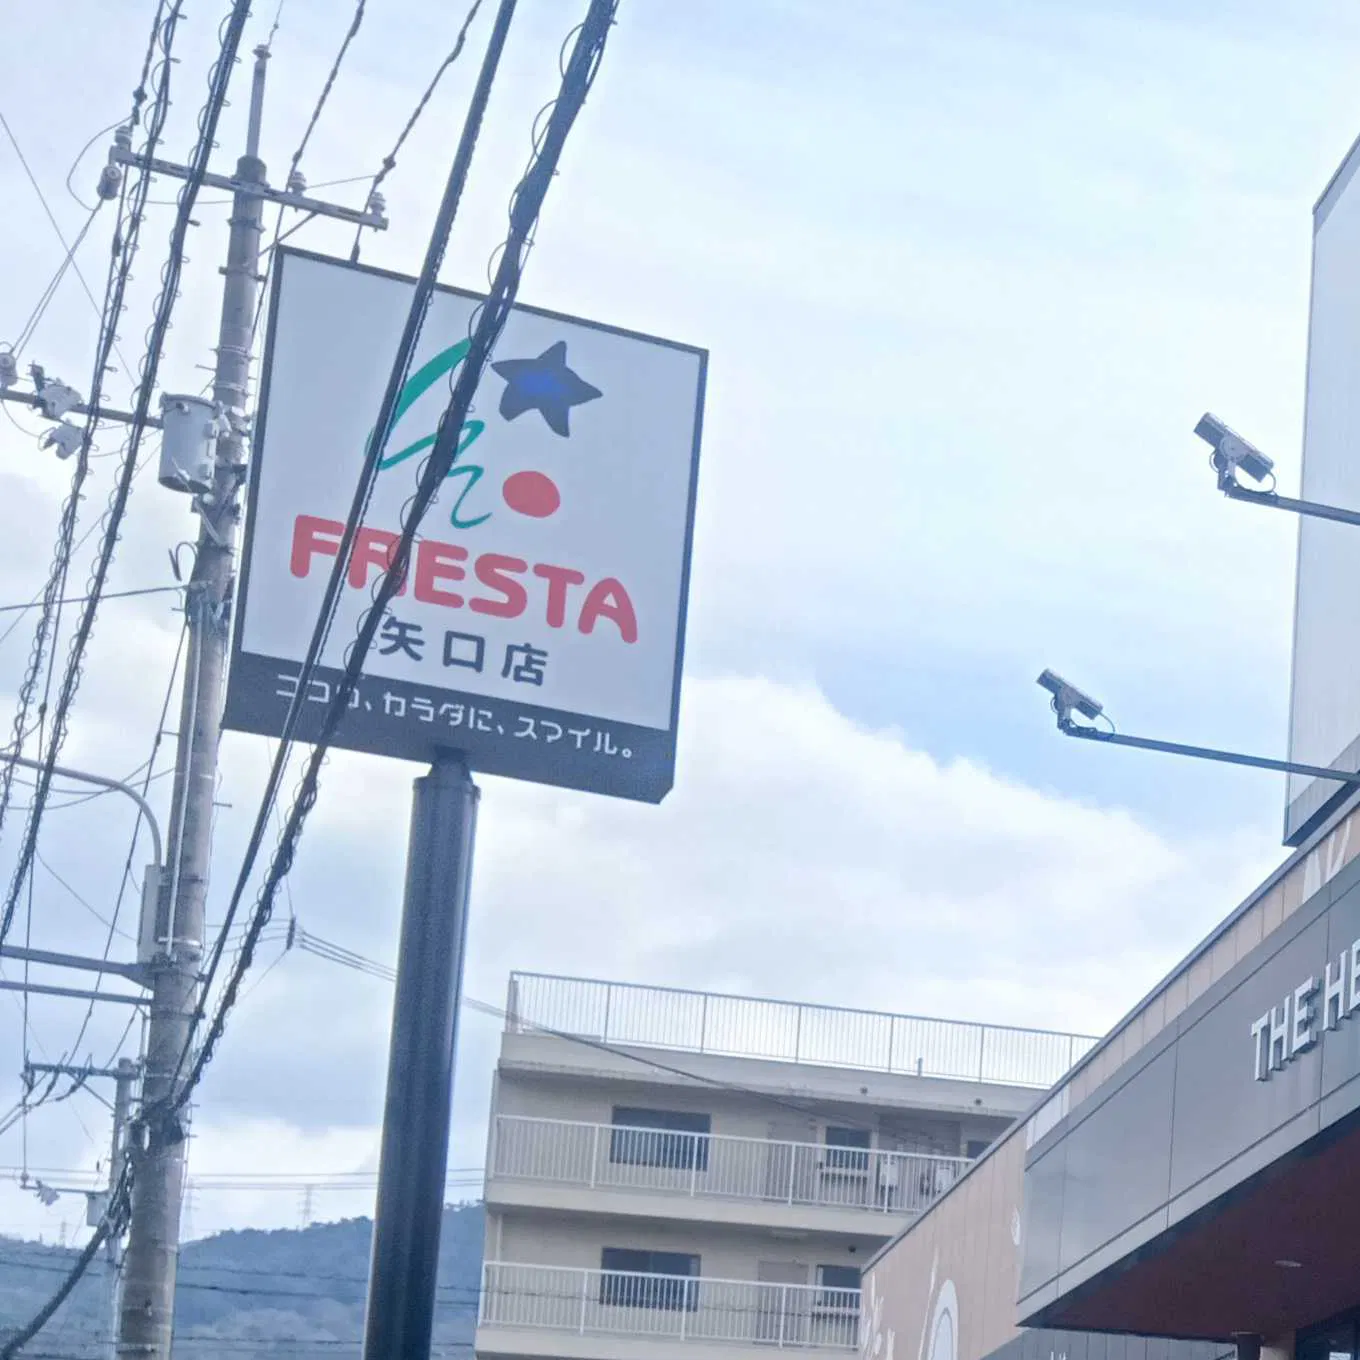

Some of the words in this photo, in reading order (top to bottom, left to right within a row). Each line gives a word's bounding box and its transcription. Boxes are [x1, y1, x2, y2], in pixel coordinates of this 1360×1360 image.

[289, 514, 639, 645] FRESTA
[377, 614, 550, 687] 矢口店
[1251, 975, 1320, 1082] THE
